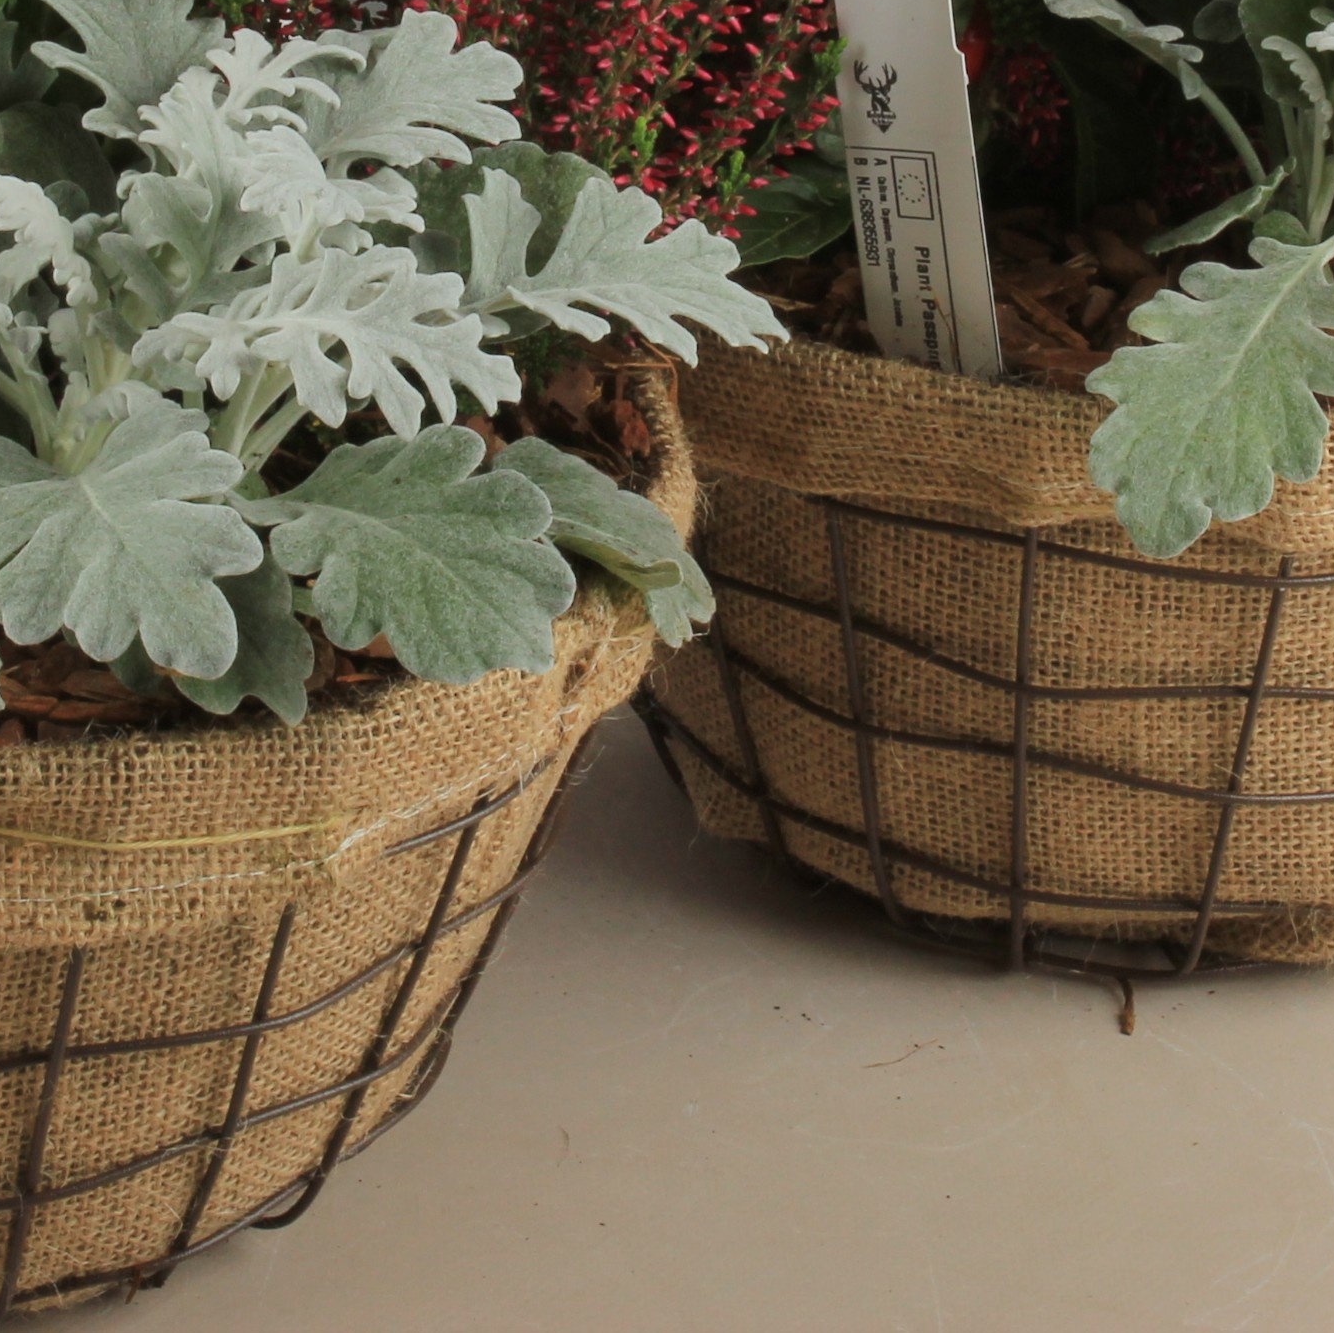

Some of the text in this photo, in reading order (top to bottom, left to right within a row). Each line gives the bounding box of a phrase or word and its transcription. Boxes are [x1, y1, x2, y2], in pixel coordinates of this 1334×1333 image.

[874, 157, 887, 166] A
[853, 157, 881, 266] B NL-638355931
[914, 246, 933, 291] Plant
